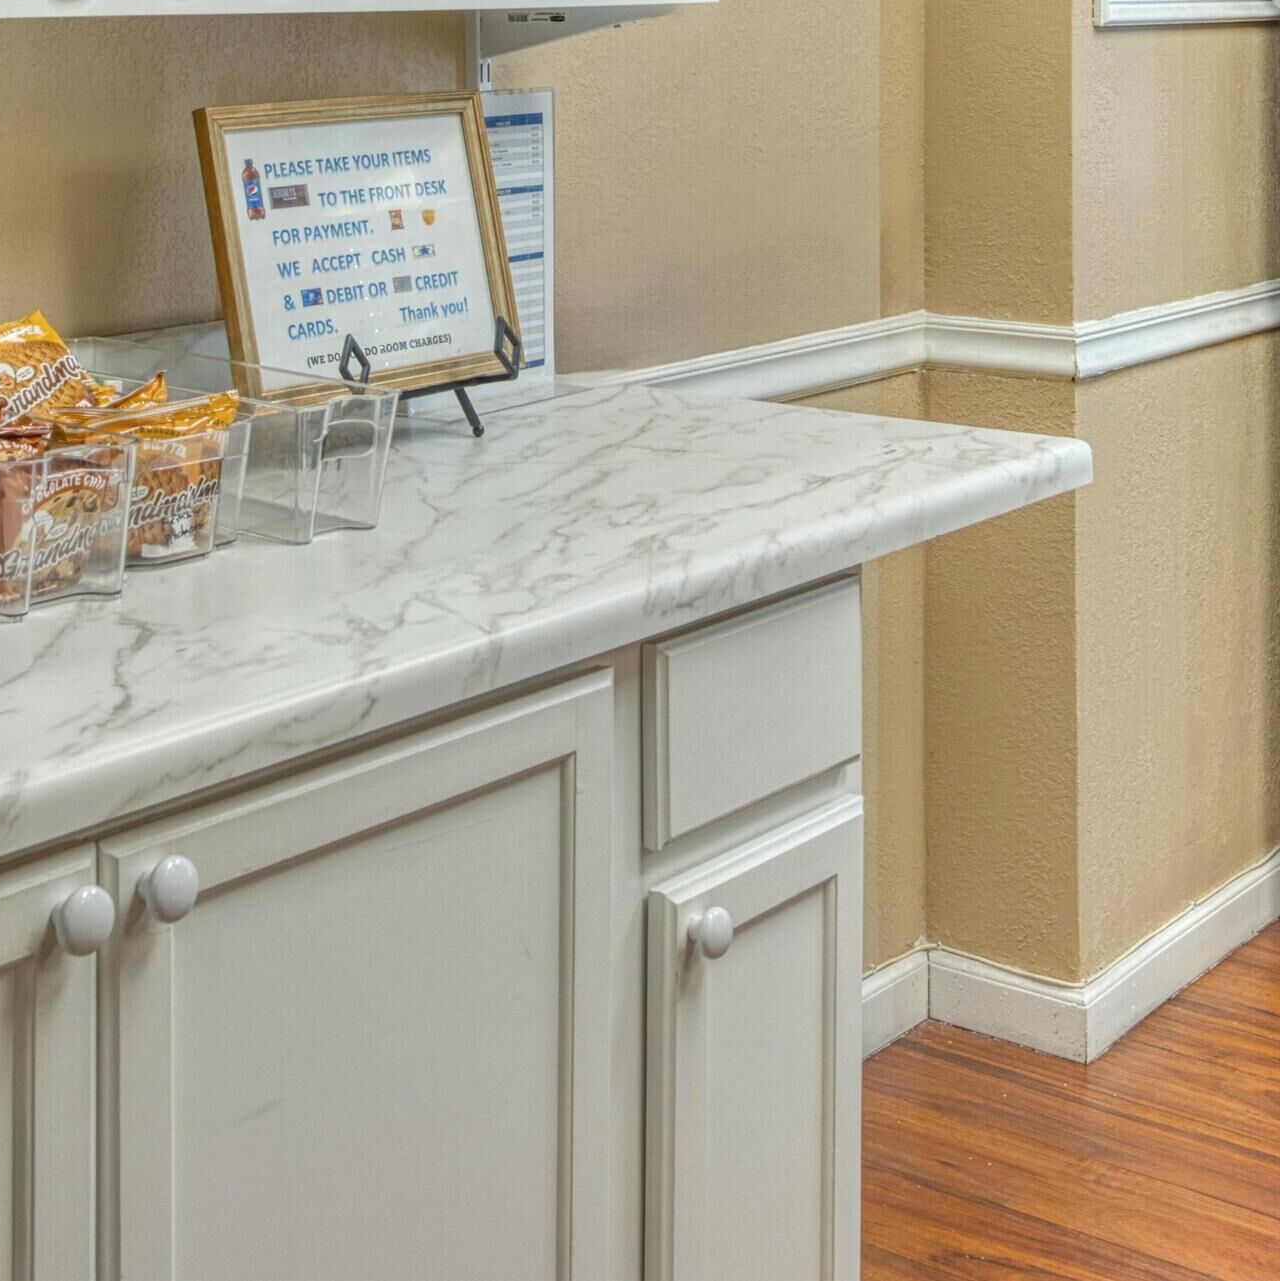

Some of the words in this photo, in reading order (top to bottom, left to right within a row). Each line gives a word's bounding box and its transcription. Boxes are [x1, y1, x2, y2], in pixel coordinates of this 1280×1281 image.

[264, 159, 313, 179] PLEASE
[316, 156, 350, 174] TAKE
[353, 152, 389, 170] YOUR
[392, 149, 431, 166] ITEMS
[318, 192, 337, 208] TO
[340, 188, 366, 205] THE
[369, 184, 412, 202] FRONT
[415, 179, 446, 196] DESK
[272, 230, 301, 246] FOR
[304, 220, 374, 241] PAYMENT.
[277, 261, 301, 278] WE
[312, 253, 360, 273] ACCEPT
[372, 247, 406, 265] CASH
[283, 295, 296, 312] &
[326, 285, 365, 304] DEBIT
[368, 281, 388, 298] OR
[415, 271, 459, 292] CREDIT
[399, 302, 438, 322] Thank
[442, 297, 469, 320] you!
[287, 319, 339, 341] CARDS.
[306, 354, 326, 369] (WE
[328, 352, 341, 362] DO
[364, 346, 378, 357] DO
[380, 341, 407, 354] ROOM
[409, 333, 452, 351] CHARGES)
